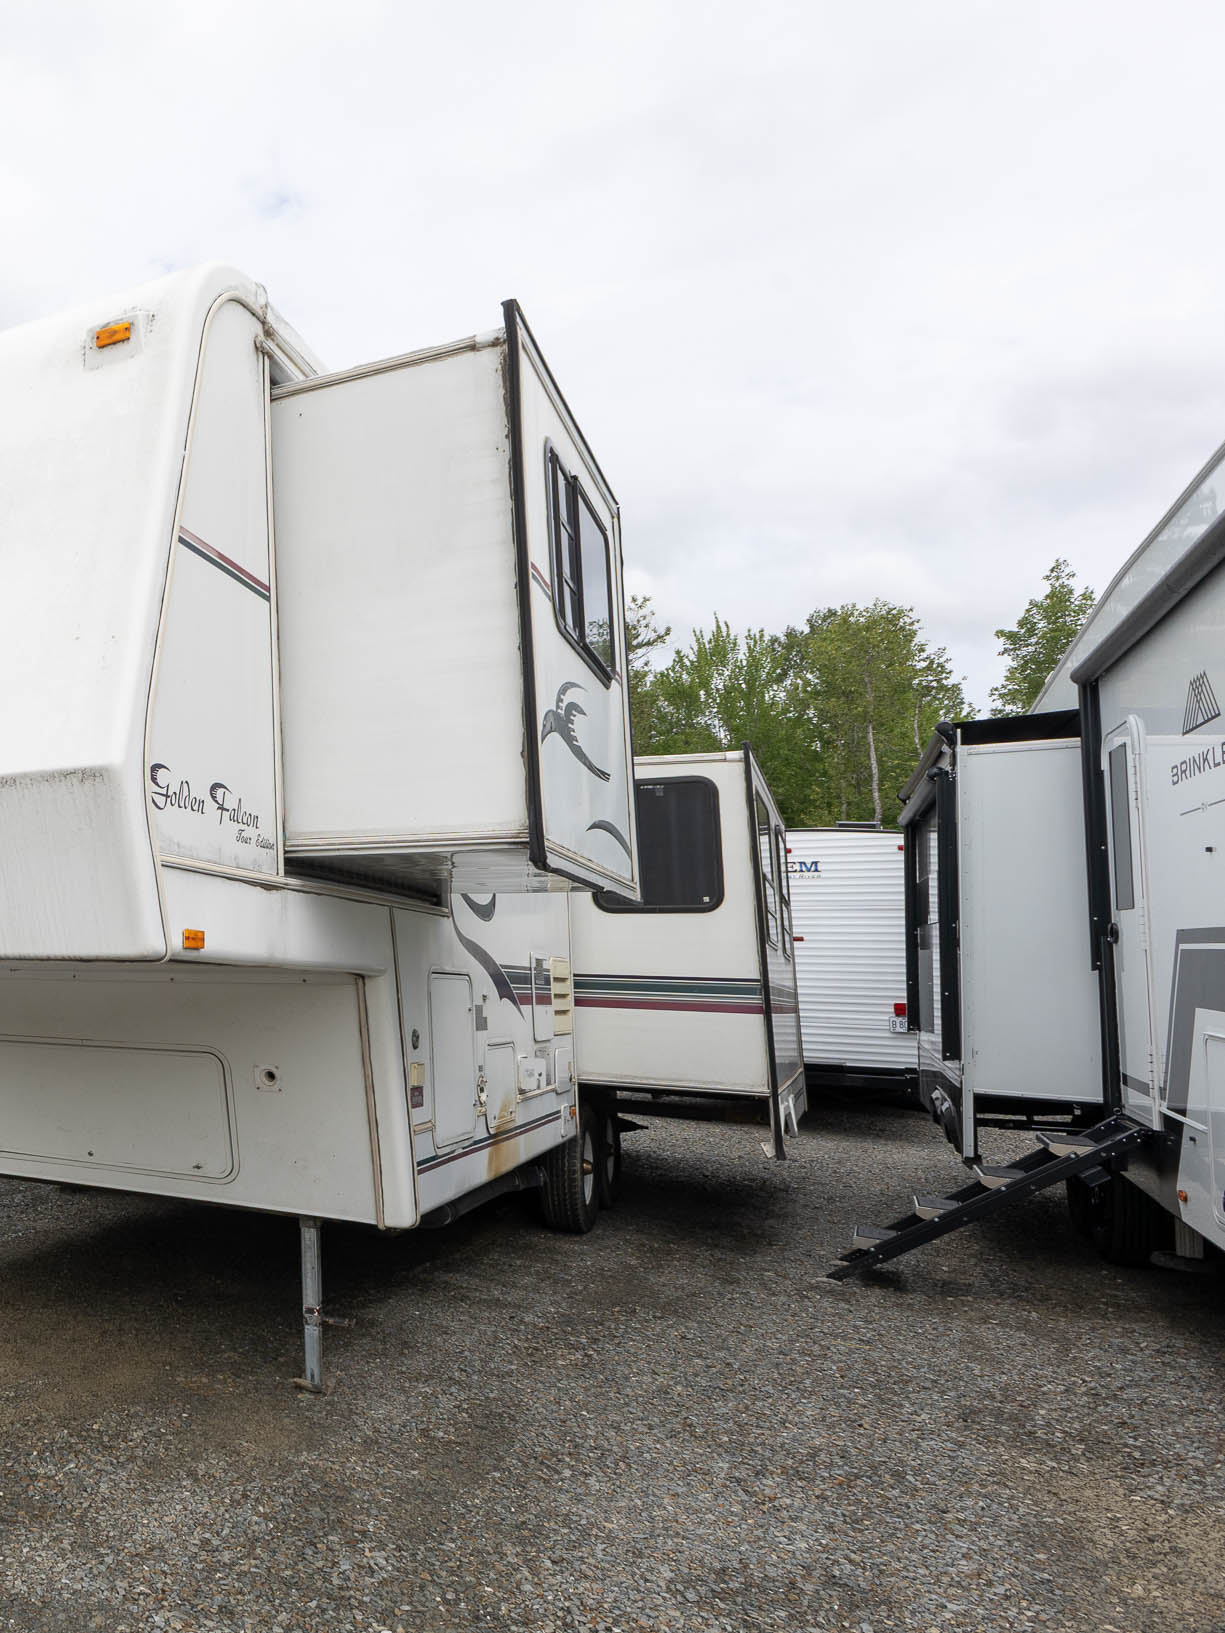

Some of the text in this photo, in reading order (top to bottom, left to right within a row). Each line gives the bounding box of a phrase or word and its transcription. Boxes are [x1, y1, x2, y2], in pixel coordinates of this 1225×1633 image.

[150, 763, 260, 829] Golden Falcon
[235, 829, 253, 845] Tour
